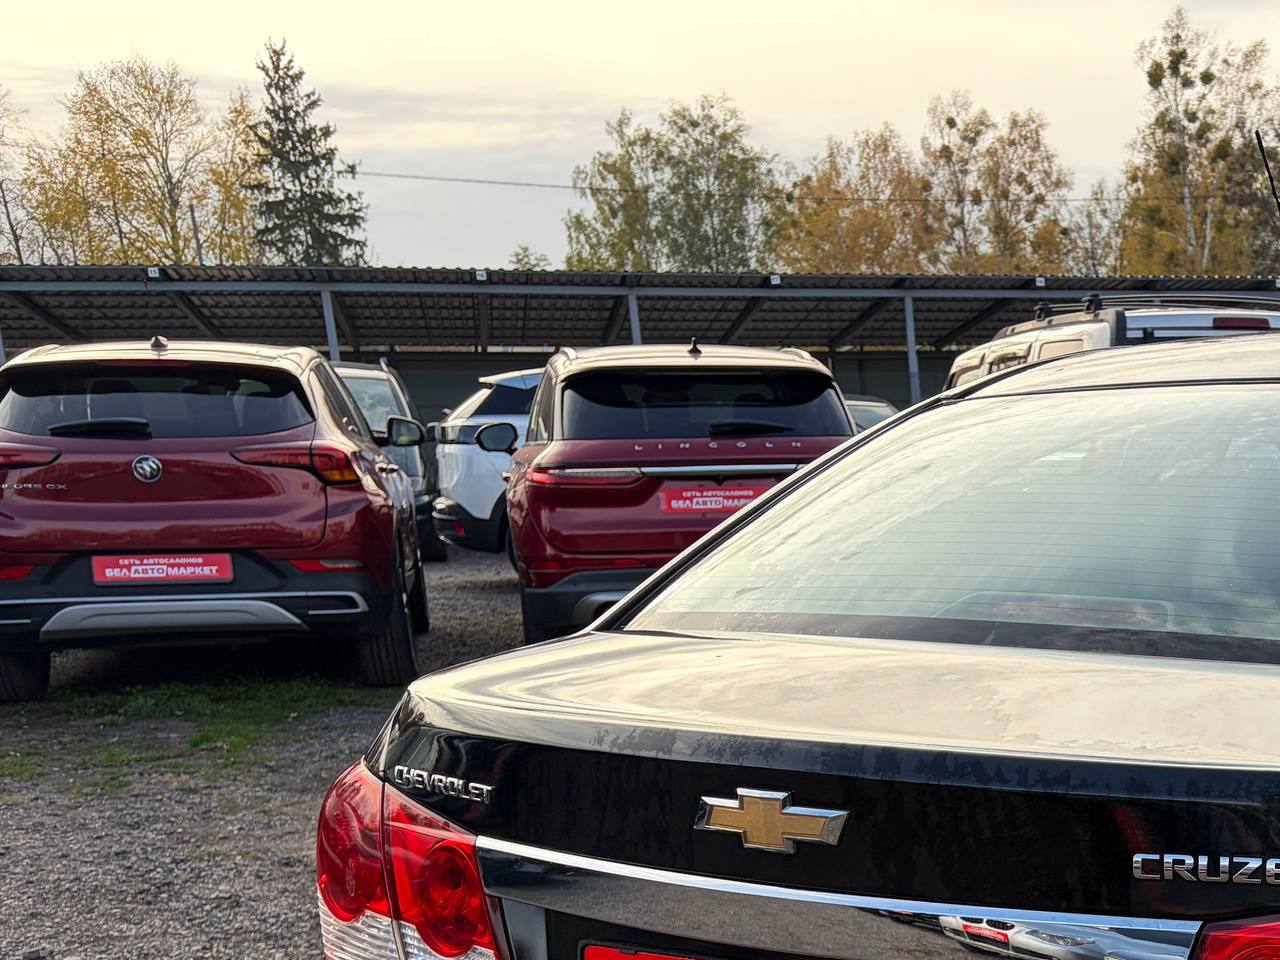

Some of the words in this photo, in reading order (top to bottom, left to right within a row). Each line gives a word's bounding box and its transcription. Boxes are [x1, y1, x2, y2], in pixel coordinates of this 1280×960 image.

[634, 440, 802, 451] LINCOLN
[119, 558, 141, 566] СЕТЬ
[143, 556, 204, 565] АВТОСАЛОНОВ
[394, 764, 496, 804] CHEVROLET
